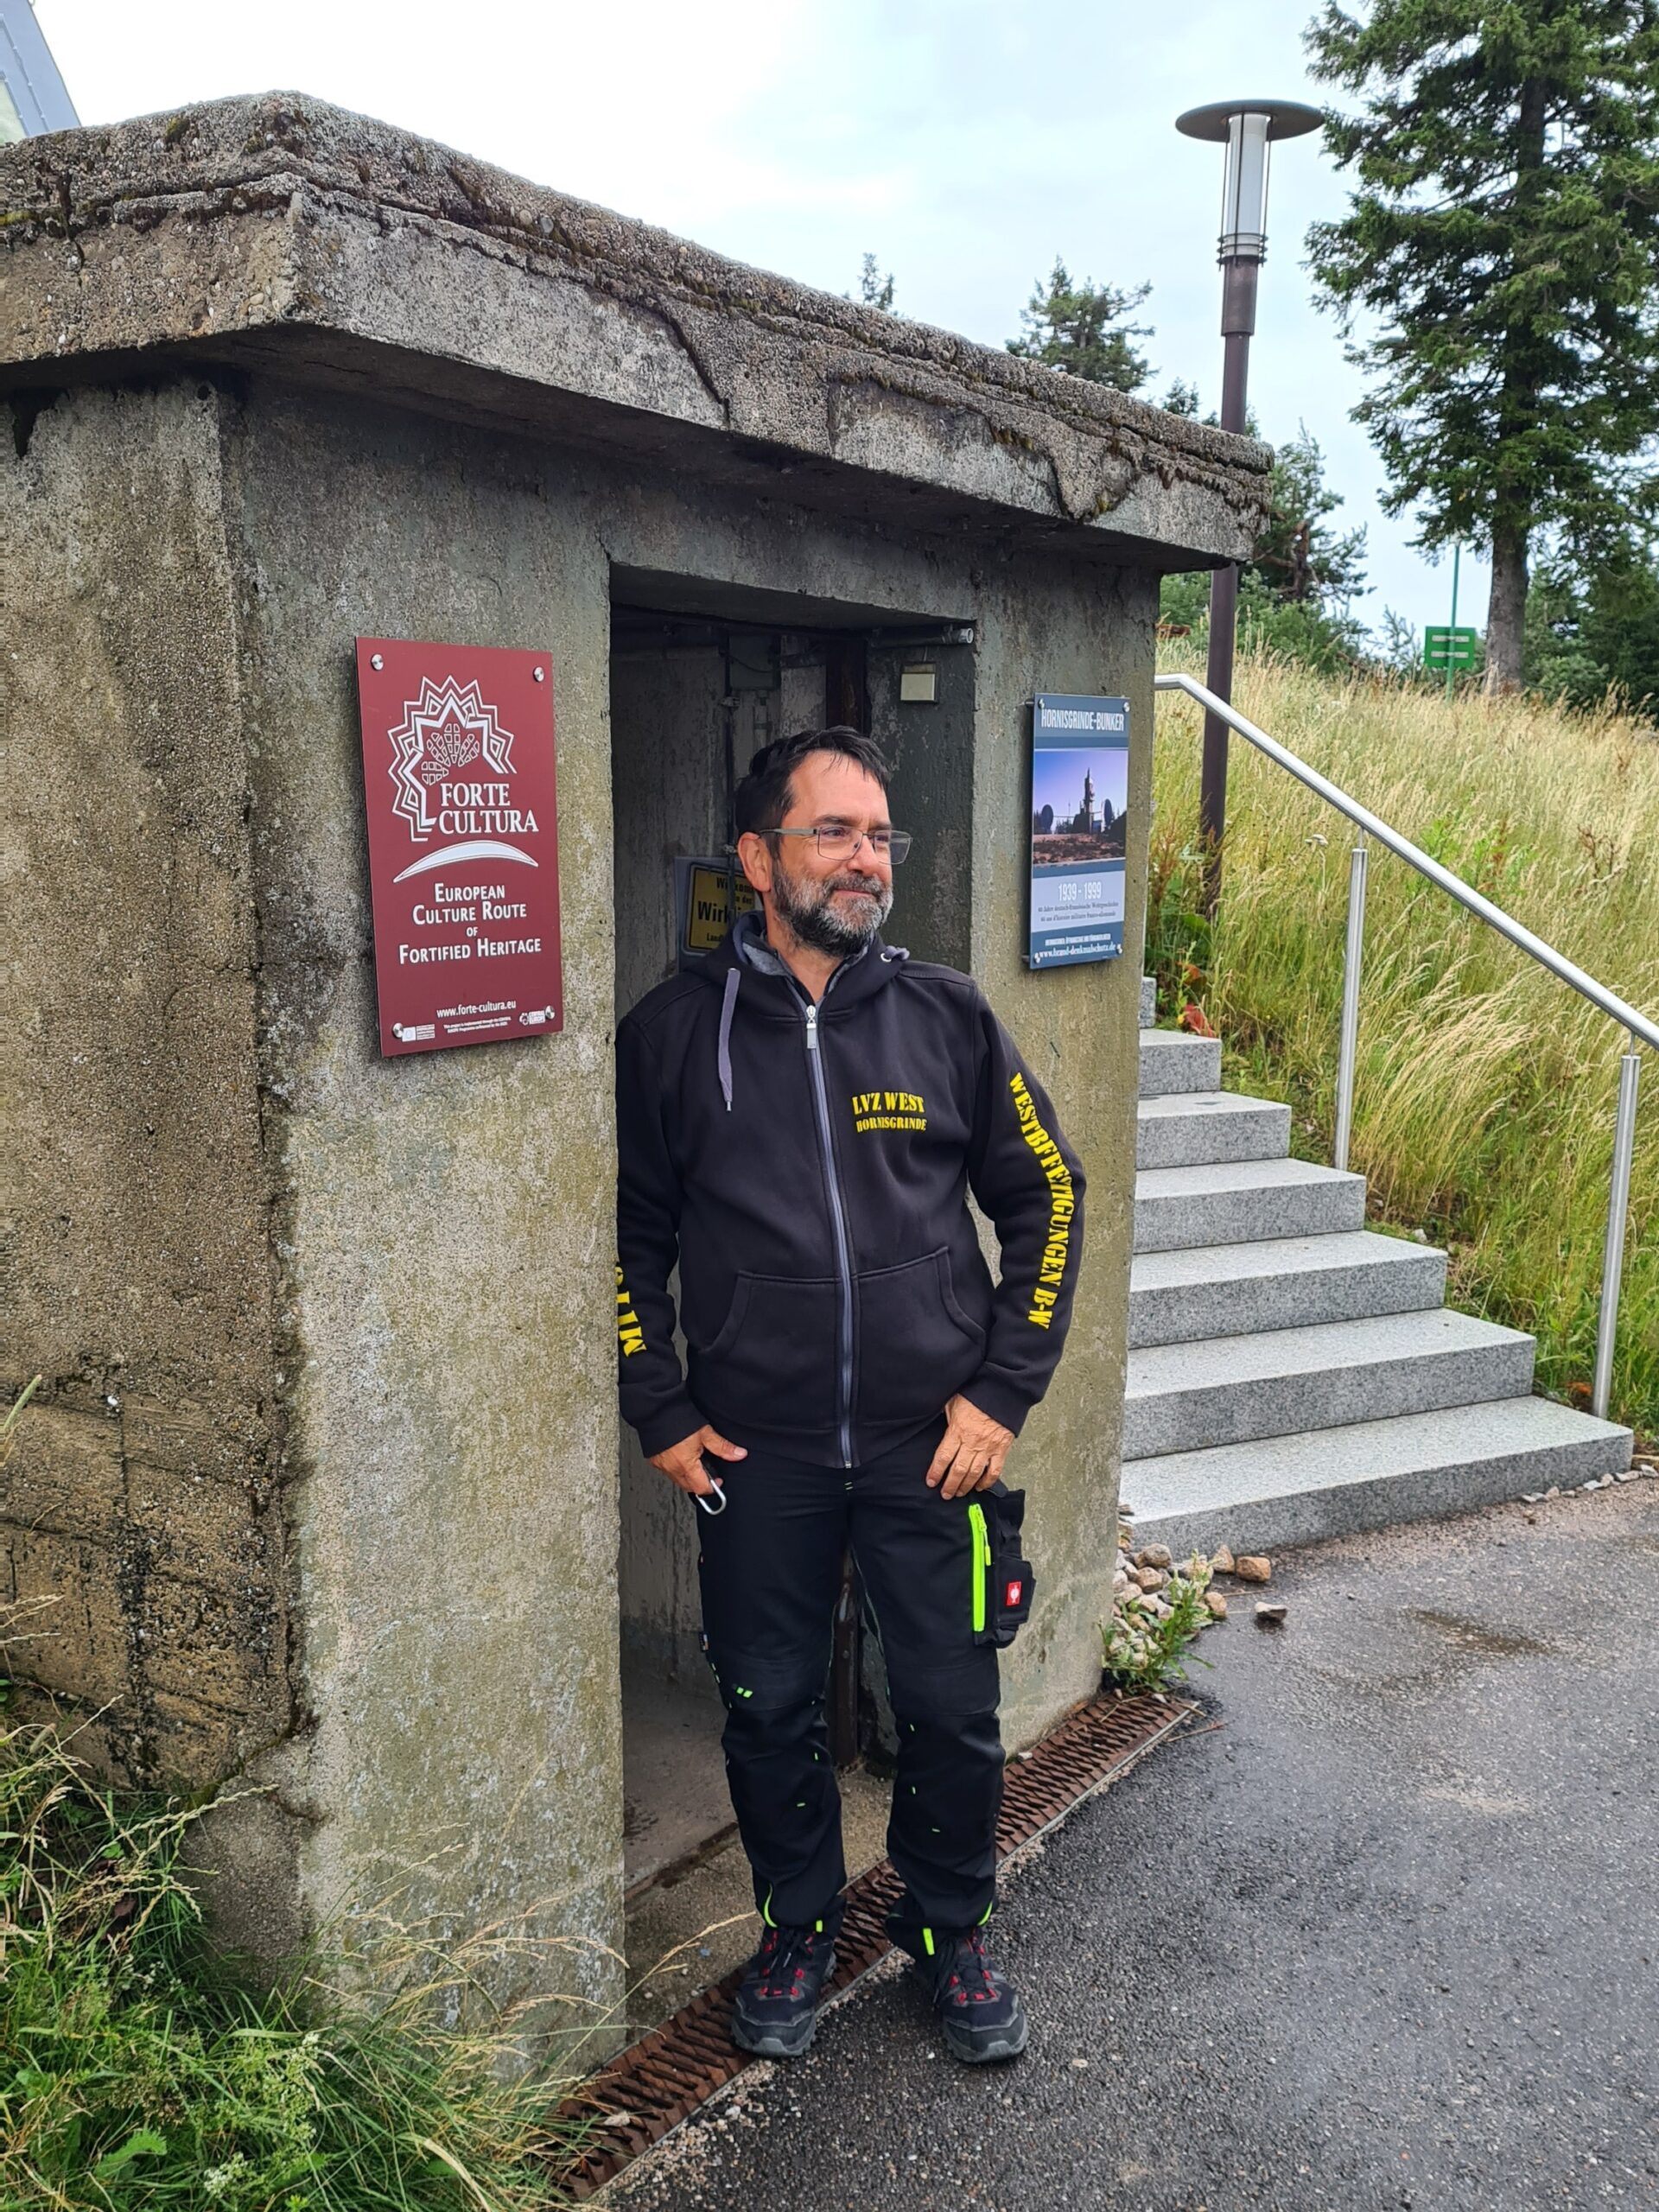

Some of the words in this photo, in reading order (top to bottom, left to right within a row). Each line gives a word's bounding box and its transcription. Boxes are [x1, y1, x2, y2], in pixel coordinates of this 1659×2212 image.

[1041, 709, 1124, 732] HORNISGRINDE-BUNKER
[441, 783, 511, 807] FORTE
[439, 810, 539, 835] CULTURA
[435, 882, 505, 903] EUROPEAN
[1058, 883, 1077, 901] 1939
[1084, 881, 1102, 899] 1999
[412, 905, 476, 925] CULTURE
[482, 901, 527, 920] ROUTE
[466, 926, 478, 937] OF
[399, 944, 471, 964] FORTIFIED
[477, 938, 542, 957] HERITAGE
[436, 1001, 517, 1018] www.forte-cultura.eu
[852, 1092, 881, 1115] LVZ
[884, 1092, 925, 1113] WEST
[856, 1116, 927, 1133] HORNISGRINDE
[1028, 1287, 1058, 1329] B-W
